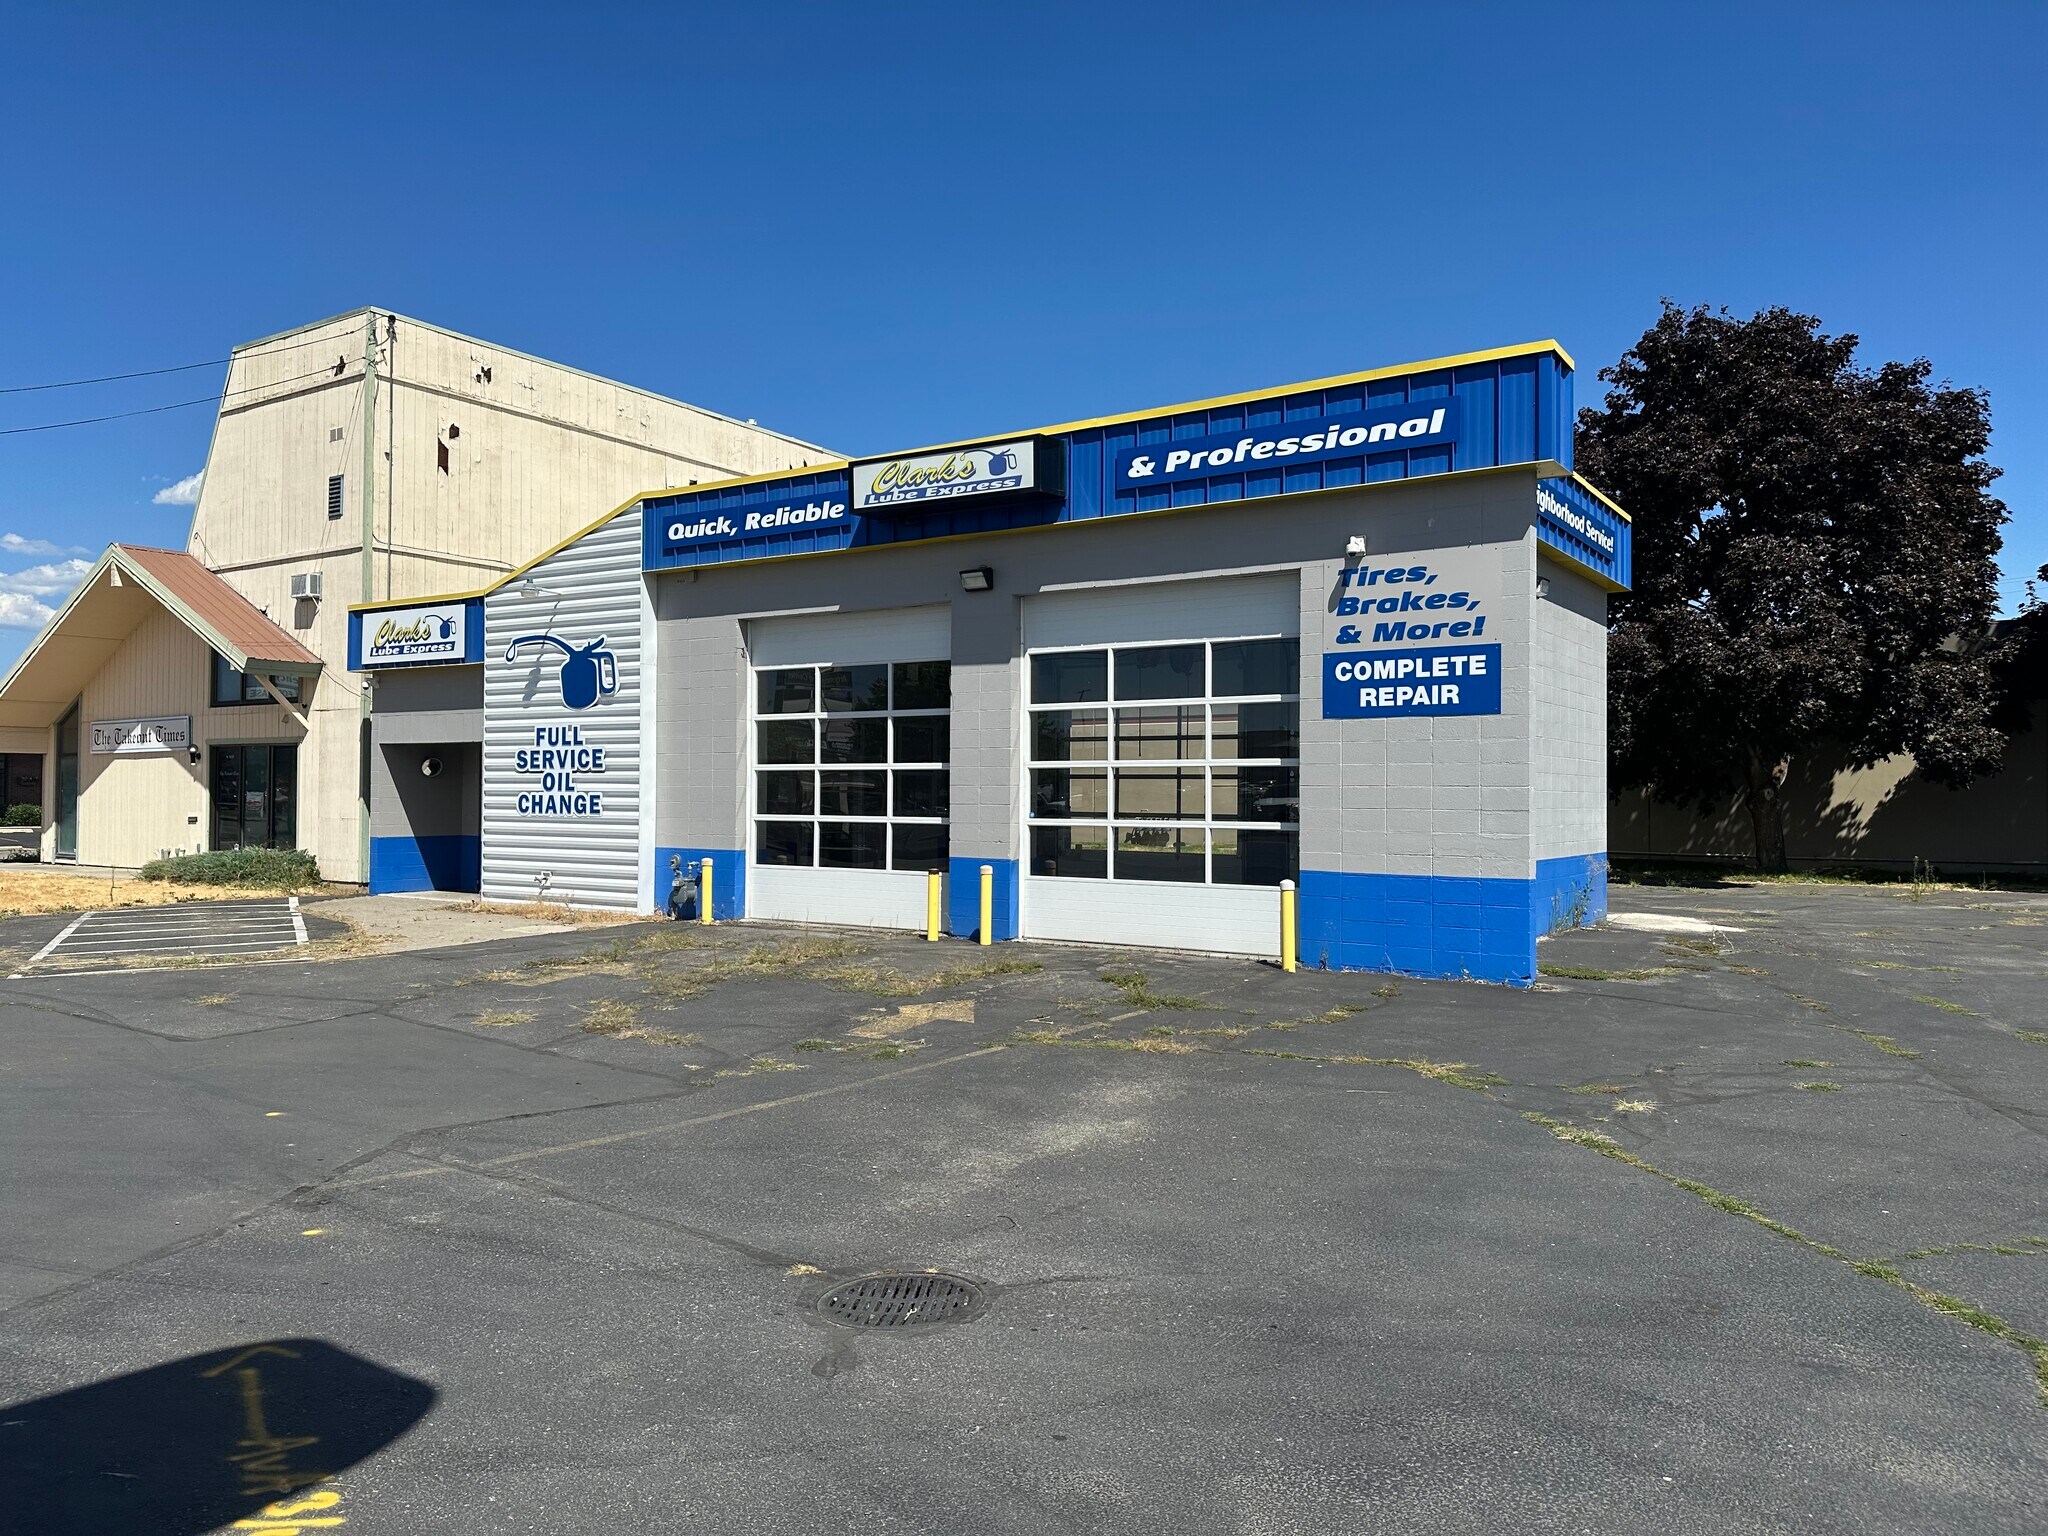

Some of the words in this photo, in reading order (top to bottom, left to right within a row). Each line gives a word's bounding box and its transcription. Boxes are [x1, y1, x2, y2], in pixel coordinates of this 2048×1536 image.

[1128, 456, 1155, 478] &
[1165, 408, 1446, 473] Professional
[871, 454, 976, 494] Clark's
[869, 487, 917, 504] Lube
[925, 479, 1017, 497] Express
[668, 516, 738, 540] Quick,
[745, 501, 845, 530] Reliable
[1537, 484, 1585, 533] ighborhood
[1586, 520, 1614, 553] Service!
[1338, 566, 1438, 588] Tires,
[1336, 591, 1481, 616] Brakes,
[1336, 625, 1362, 644] &
[1372, 616, 1486, 642] More!
[372, 645, 400, 656] Lube
[403, 643, 453, 654] Express
[1335, 655, 1487, 682] COMPLETE
[1359, 684, 1460, 708] REPAIR
[94, 729, 111, 746] The
[114, 728, 152, 745] Takeout
[155, 725, 185, 742] Times
[536, 726, 583, 747] FULL
[516, 749, 603, 769] SERVICE
[542, 772, 575, 792] OIL
[518, 794, 600, 814] CHANGE
